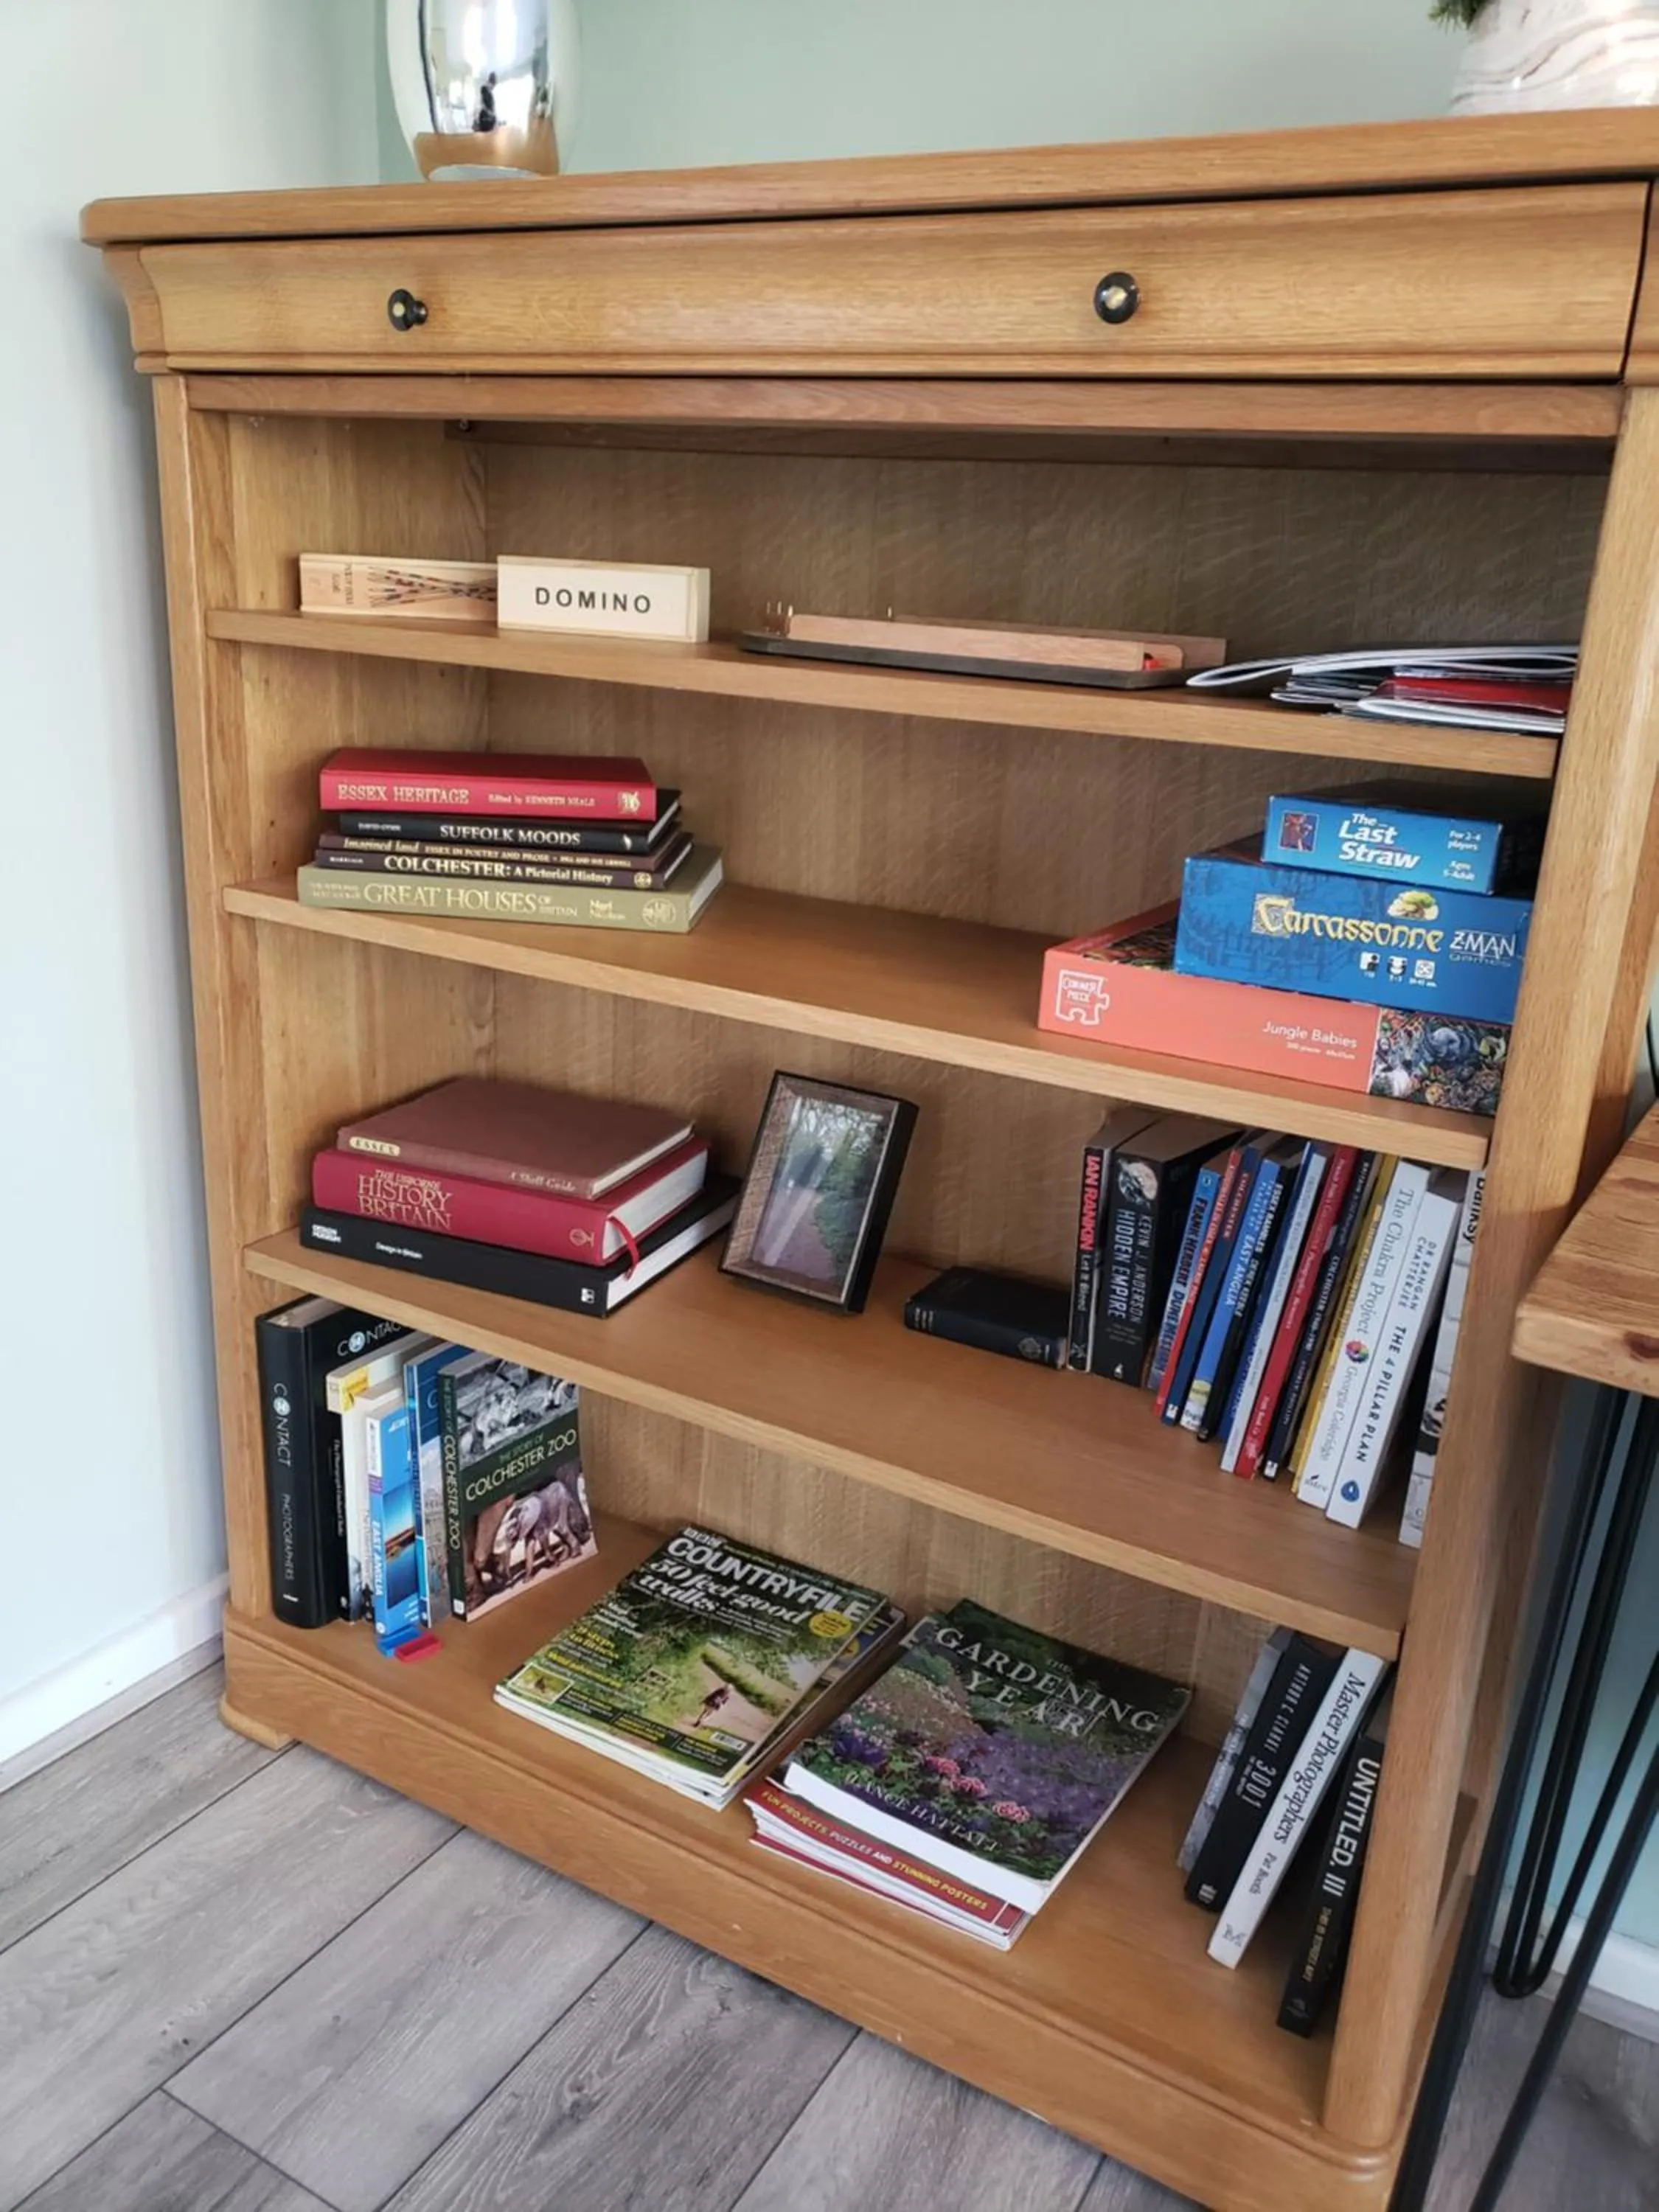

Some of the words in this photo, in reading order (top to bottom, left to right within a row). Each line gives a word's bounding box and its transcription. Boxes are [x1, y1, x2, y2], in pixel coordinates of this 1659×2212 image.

[535, 587, 651, 615] DOMINO
[338, 784, 389, 801] ESSEX
[393, 786, 469, 804] HERITAGE
[440, 824, 514, 842] SUFFOLK
[518, 829, 581, 846] MOODS
[1338, 820, 1398, 845] Last
[1352, 813, 1377, 826] The
[384, 855, 511, 877] COLCHESTER:
[514, 867, 522, 876] A
[525, 866, 570, 880] Pictorial
[573, 870, 613, 885] History
[1339, 840, 1421, 869] Straw
[364, 883, 440, 908] GREAT
[446, 888, 538, 914] HOUSES
[1262, 1020, 1308, 1040] Jungle
[1312, 1029, 1357, 1048] Babies
[1084, 1155, 1102, 1185] IAN
[358, 1174, 453, 1212] HISTORY
[358, 1195, 452, 1230] BRITAIN
[1266, 1183, 1283, 1212] ESSEX
[1391, 1186, 1414, 1220] The
[1077, 1186, 1100, 1251] RANKIN
[1111, 1208, 1137, 1262] HIDDEN
[1136, 1214, 1153, 1248] KEVIN
[1186, 1197, 1208, 1237] FRANK
[1253, 1211, 1274, 1253] RAMBLES
[1080, 1253, 1091, 1270] Let
[1174, 1236, 1199, 1287] HERBERT
[1237, 1233, 1256, 1263] EAST
[1371, 1220, 1405, 1280] Chakra
[1425, 1240, 1437, 1257] DR
[1106, 1265, 1131, 1319] EMPIRE
[1223, 1262, 1246, 1307] ANGLIA
[1314, 1256, 1340, 1319] COLCHESTER
[1397, 1235, 1427, 1308] CHATTERJEE
[1408, 1260, 1431, 1311] RANGAN
[1127, 1264, 1148, 1322] ANDERSON
[1352, 1279, 1385, 1336] Project
[1387, 1324, 1408, 1354] THE
[1332, 1364, 1358, 1410] Georgia
[1366, 1369, 1393, 1422] PILLAR
[1315, 1408, 1346, 1464] Coleridge
[1354, 1425, 1376, 1463] PLAN
[443, 1434, 458, 1517] COLCHESTER
[465, 1446, 546, 1501] COLCHESTER
[546, 1428, 577, 1457] ZOO
[372, 1520, 382, 1551] EAST
[448, 1517, 461, 1551] ZOO
[373, 1552, 384, 1596] ANGLIA
[650, 1558, 693, 1581] 50
[667, 1537, 871, 1622] COUNTRYFILE
[639, 1575, 717, 1613] walks
[935, 1627, 1161, 1735] GARDENING
[1283, 1660, 1312, 1705] ARTHUR
[967, 1670, 1087, 1739] YEAR
[1322, 1669, 1368, 1739] Master
[1261, 1712, 1290, 1755] CLARKE
[1239, 1756, 1280, 1812] 3001
[1267, 1726, 1341, 1849] Photographers
[762, 1791, 781, 1809] FUN
[829, 1831, 872, 1856] PUZZLES
[872, 1851, 892, 1865] AND
[891, 1860, 941, 1889] STUNNING
[939, 1882, 989, 1912] POSTERS
[1260, 1850, 1278, 1869] Pat
[1320, 1871, 1347, 1897] III
